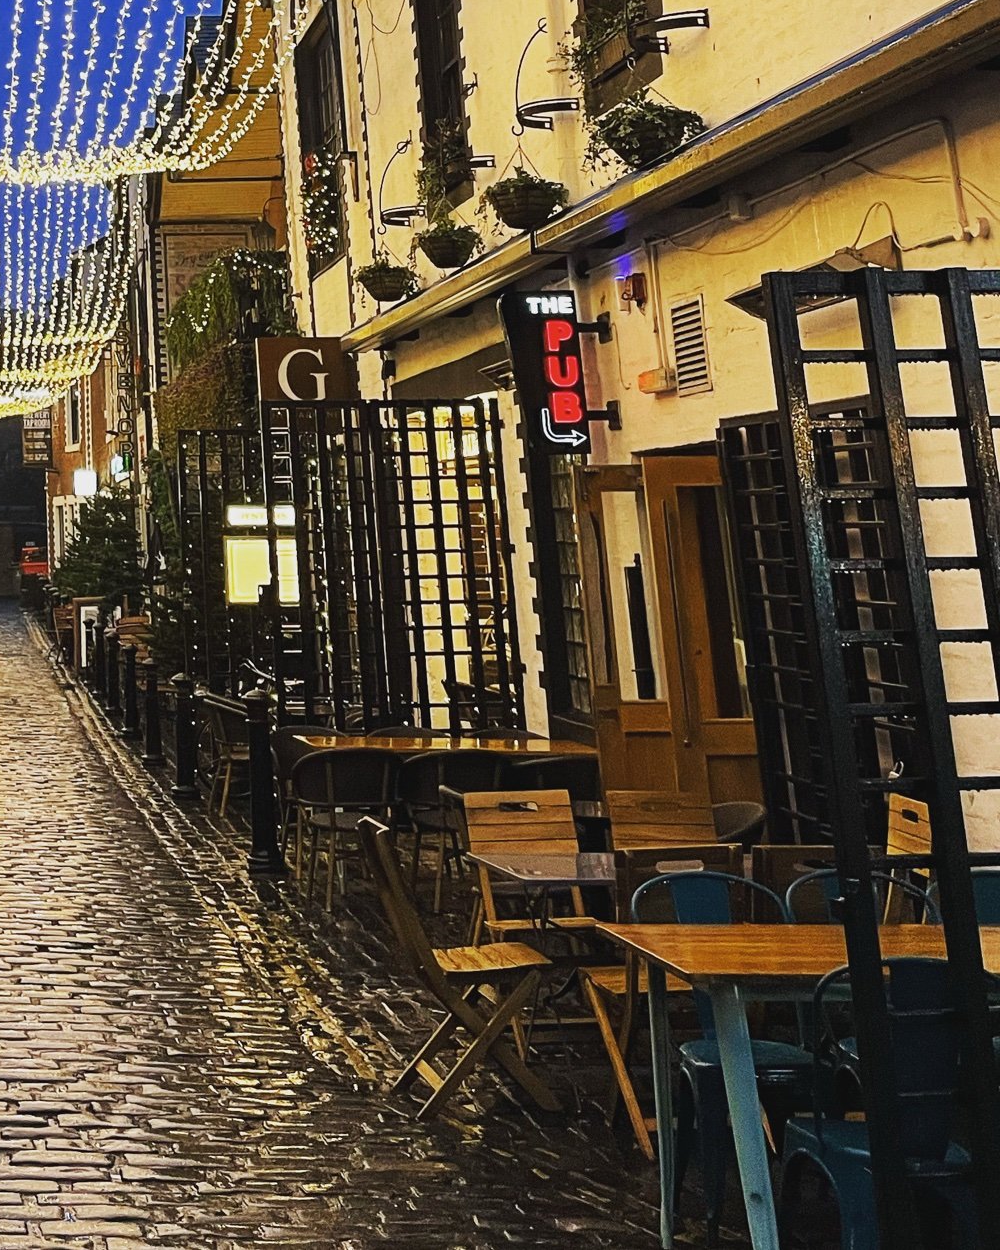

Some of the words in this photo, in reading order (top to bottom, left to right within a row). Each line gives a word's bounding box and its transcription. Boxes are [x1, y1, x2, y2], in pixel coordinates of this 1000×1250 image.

[525, 296, 574, 315] THE
[277, 348, 330, 401] G
[544, 319, 583, 424] PUB
